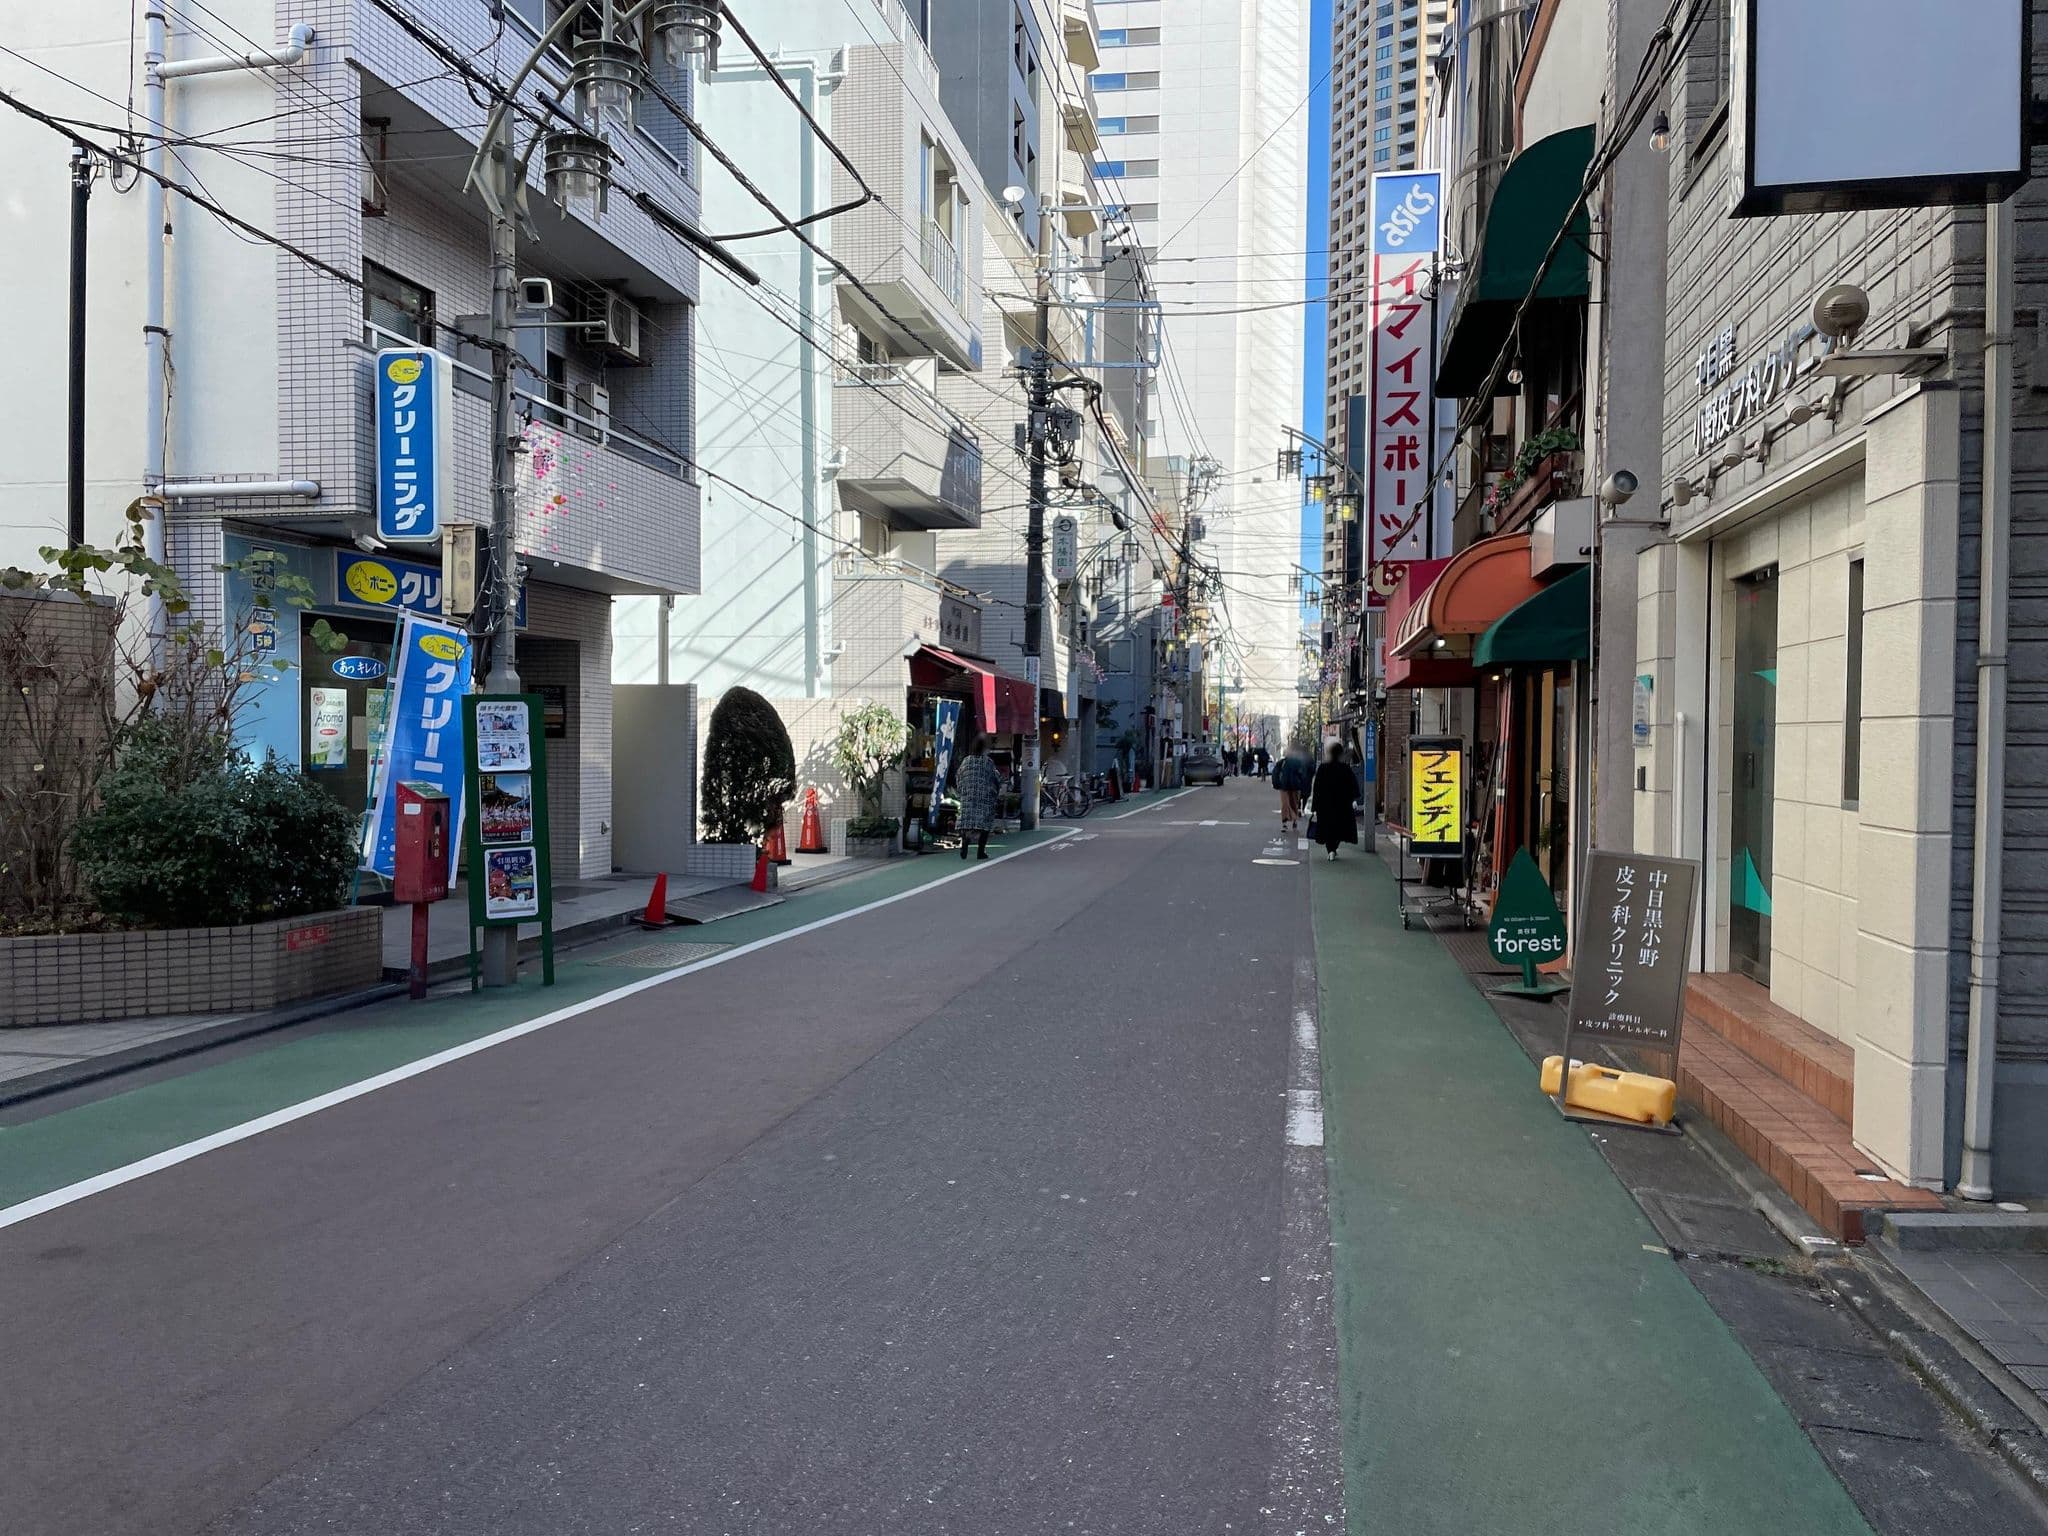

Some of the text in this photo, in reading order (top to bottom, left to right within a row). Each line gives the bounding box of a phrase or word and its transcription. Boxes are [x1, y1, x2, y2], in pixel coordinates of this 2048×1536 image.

[1380, 183, 1435, 246] asics
[1380, 258, 1423, 547] イマイスポーツ
[393, 385, 426, 531] クリーニング
[369, 576, 395, 592] ポニー
[1494, 928, 1562, 953] forest
[1604, 865, 1635, 1006] 皮フ科クリニック
[1639, 869, 1667, 967] 中目黒小野
